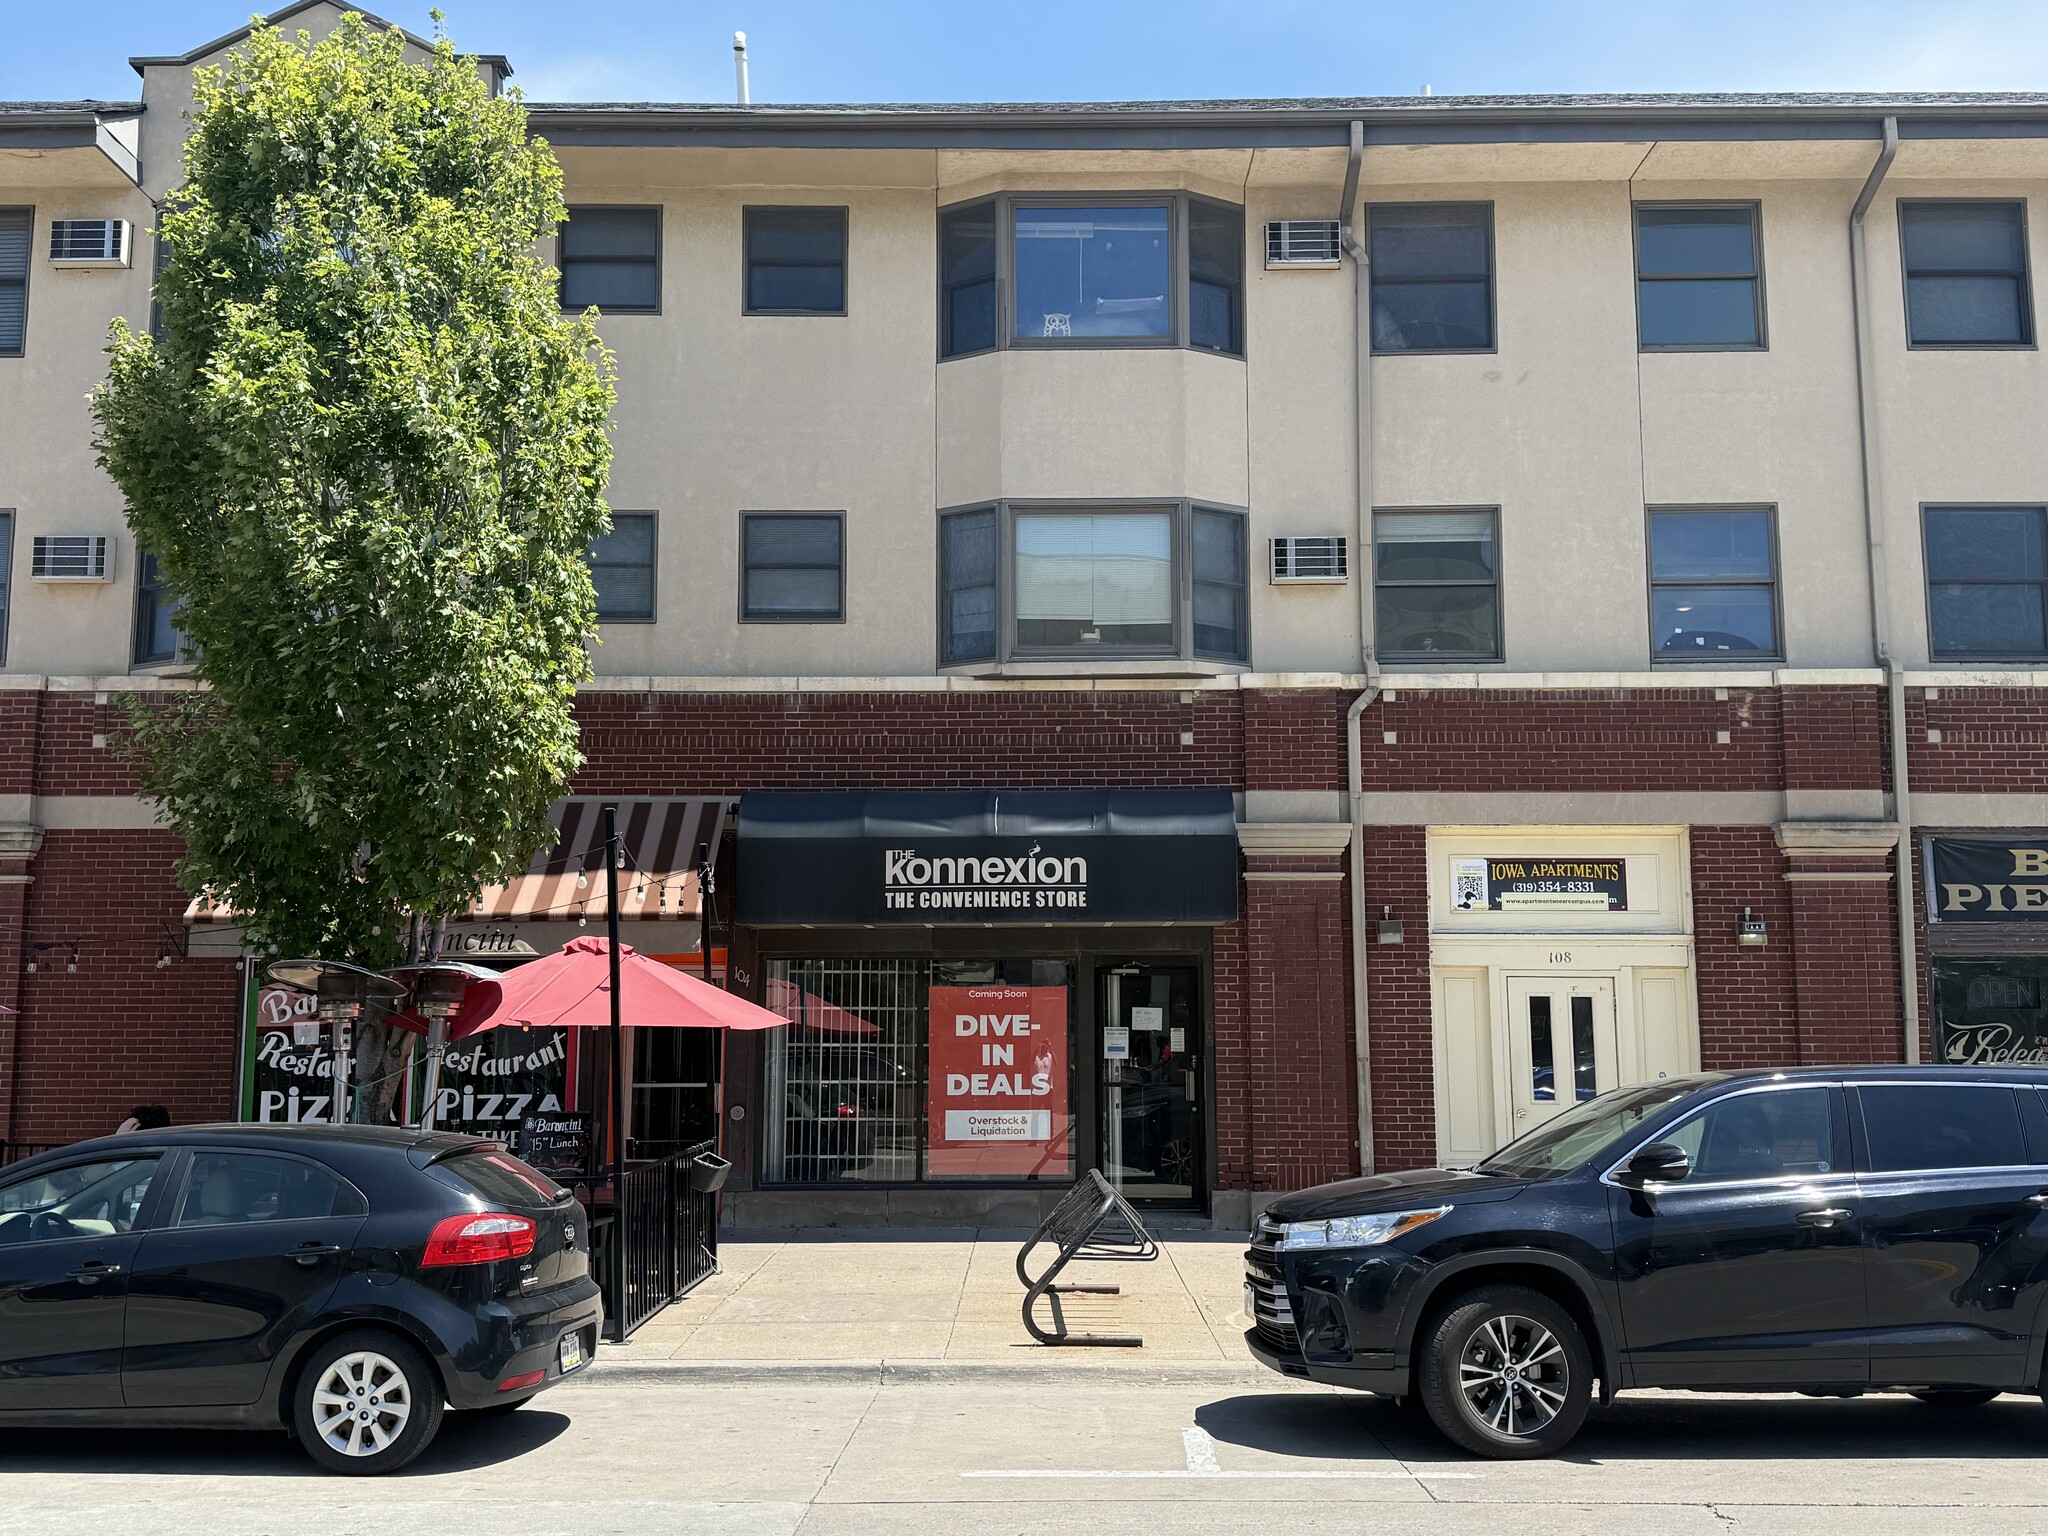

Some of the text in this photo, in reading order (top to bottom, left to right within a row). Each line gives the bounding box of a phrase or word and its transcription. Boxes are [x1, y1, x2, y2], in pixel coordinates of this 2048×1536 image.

[893, 850, 915, 859] THE
[1491, 863, 1619, 881] IOWA APARTMENTS
[885, 891, 1087, 908] THE CONVENIENCE STORE
[1549, 952, 1572, 963] 108
[734, 966, 750, 988] 104
[968, 990, 1027, 1000] Coming Soon
[1969, 978, 2034, 1008] OPEN
[955, 1014, 1041, 1037] DIVE-
[440, 1031, 566, 1077] estaurant
[982, 1044, 1014, 1066] IN
[946, 1073, 1051, 1096] DEALS
[535, 1118, 582, 1133] Baroncini
[968, 1116, 1028, 1125] Overstock &
[970, 1126, 1026, 1137] Liquidation
[549, 1135, 579, 1149] Lunch
